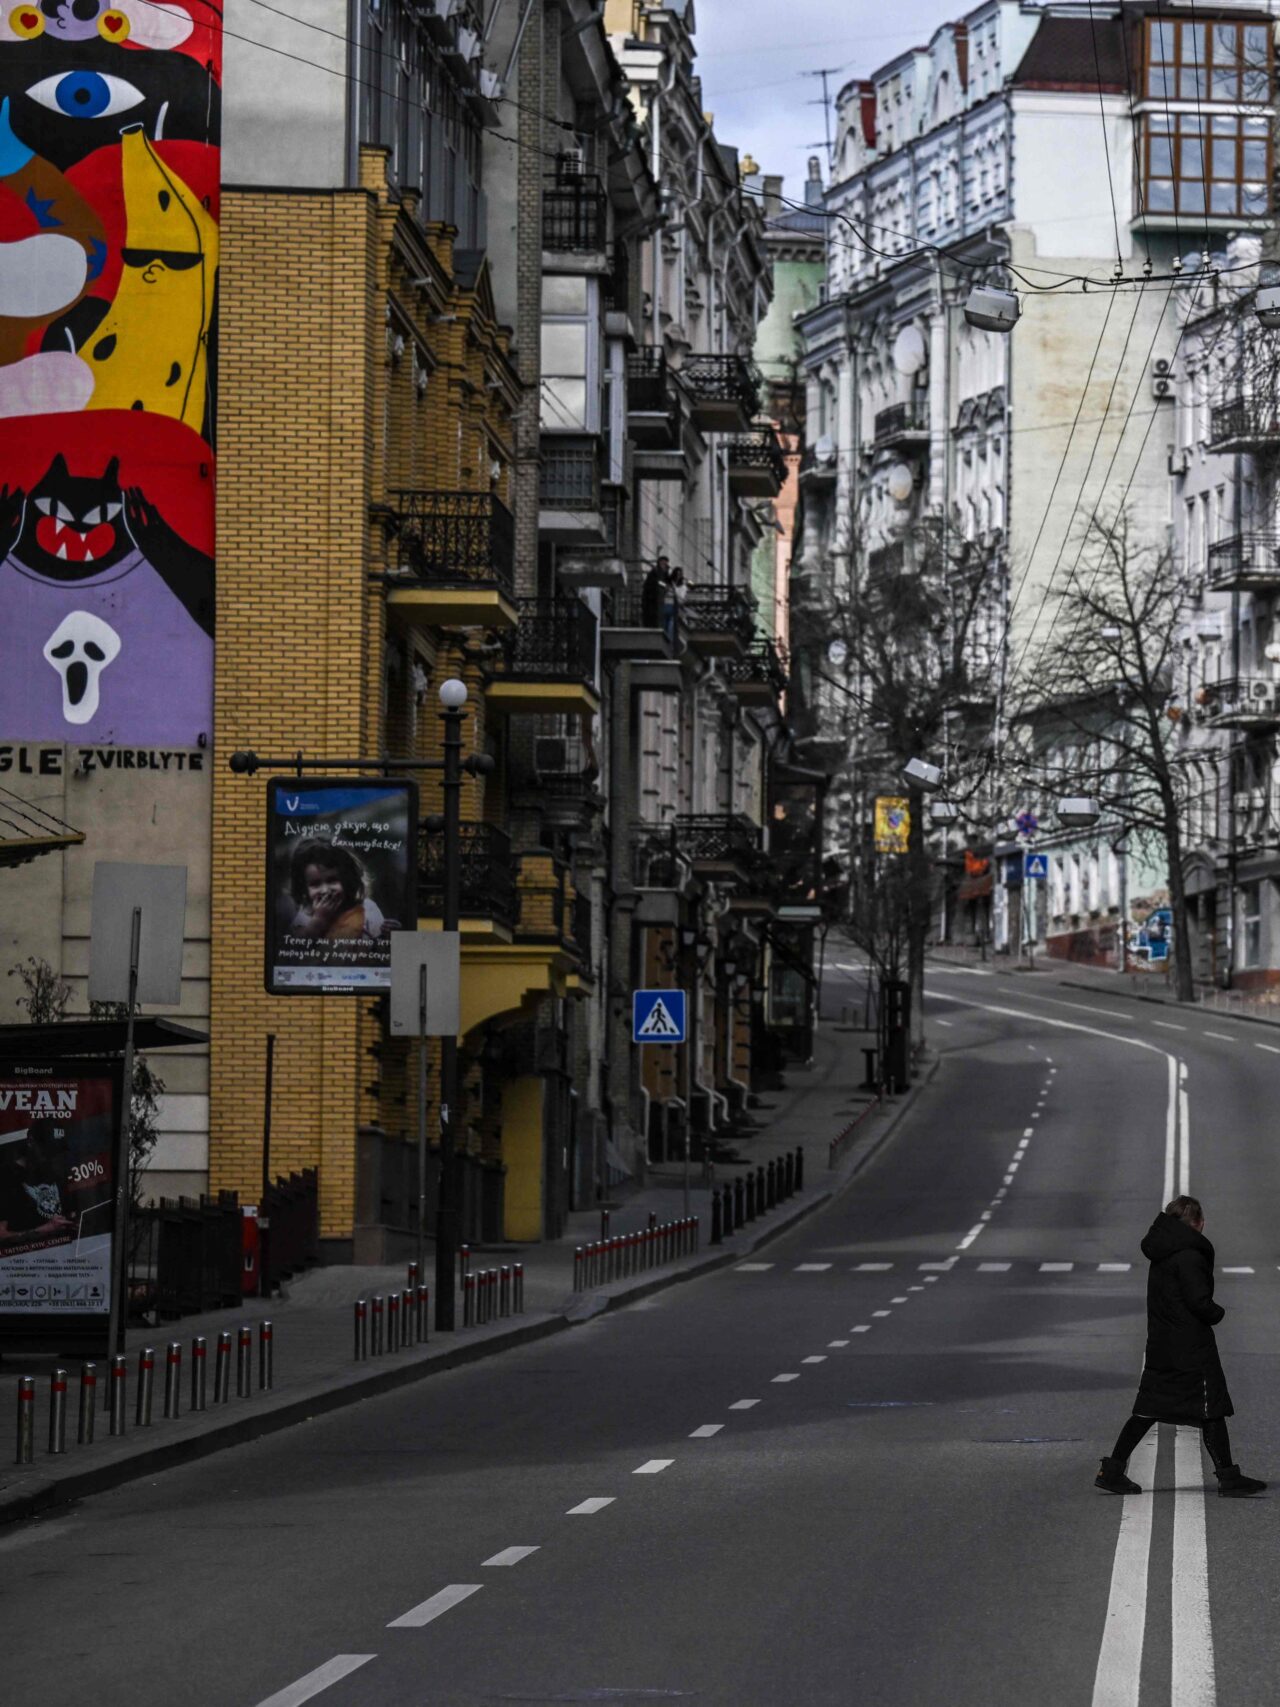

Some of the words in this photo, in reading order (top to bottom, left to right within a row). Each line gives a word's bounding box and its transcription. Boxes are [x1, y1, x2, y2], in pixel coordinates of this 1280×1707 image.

[78, 748, 204, 771] ZVIRBLYTE
[334, 821, 371, 835] дякую,
[371, 822, 390, 834] що
[283, 934, 312, 948] Тепер
[14, 1066, 53, 1075] BigBoard
[0, 1090, 78, 1110] VEAN
[30, 1110, 72, 1119] TATTOO
[67, 1160, 104, 1182] -30%
